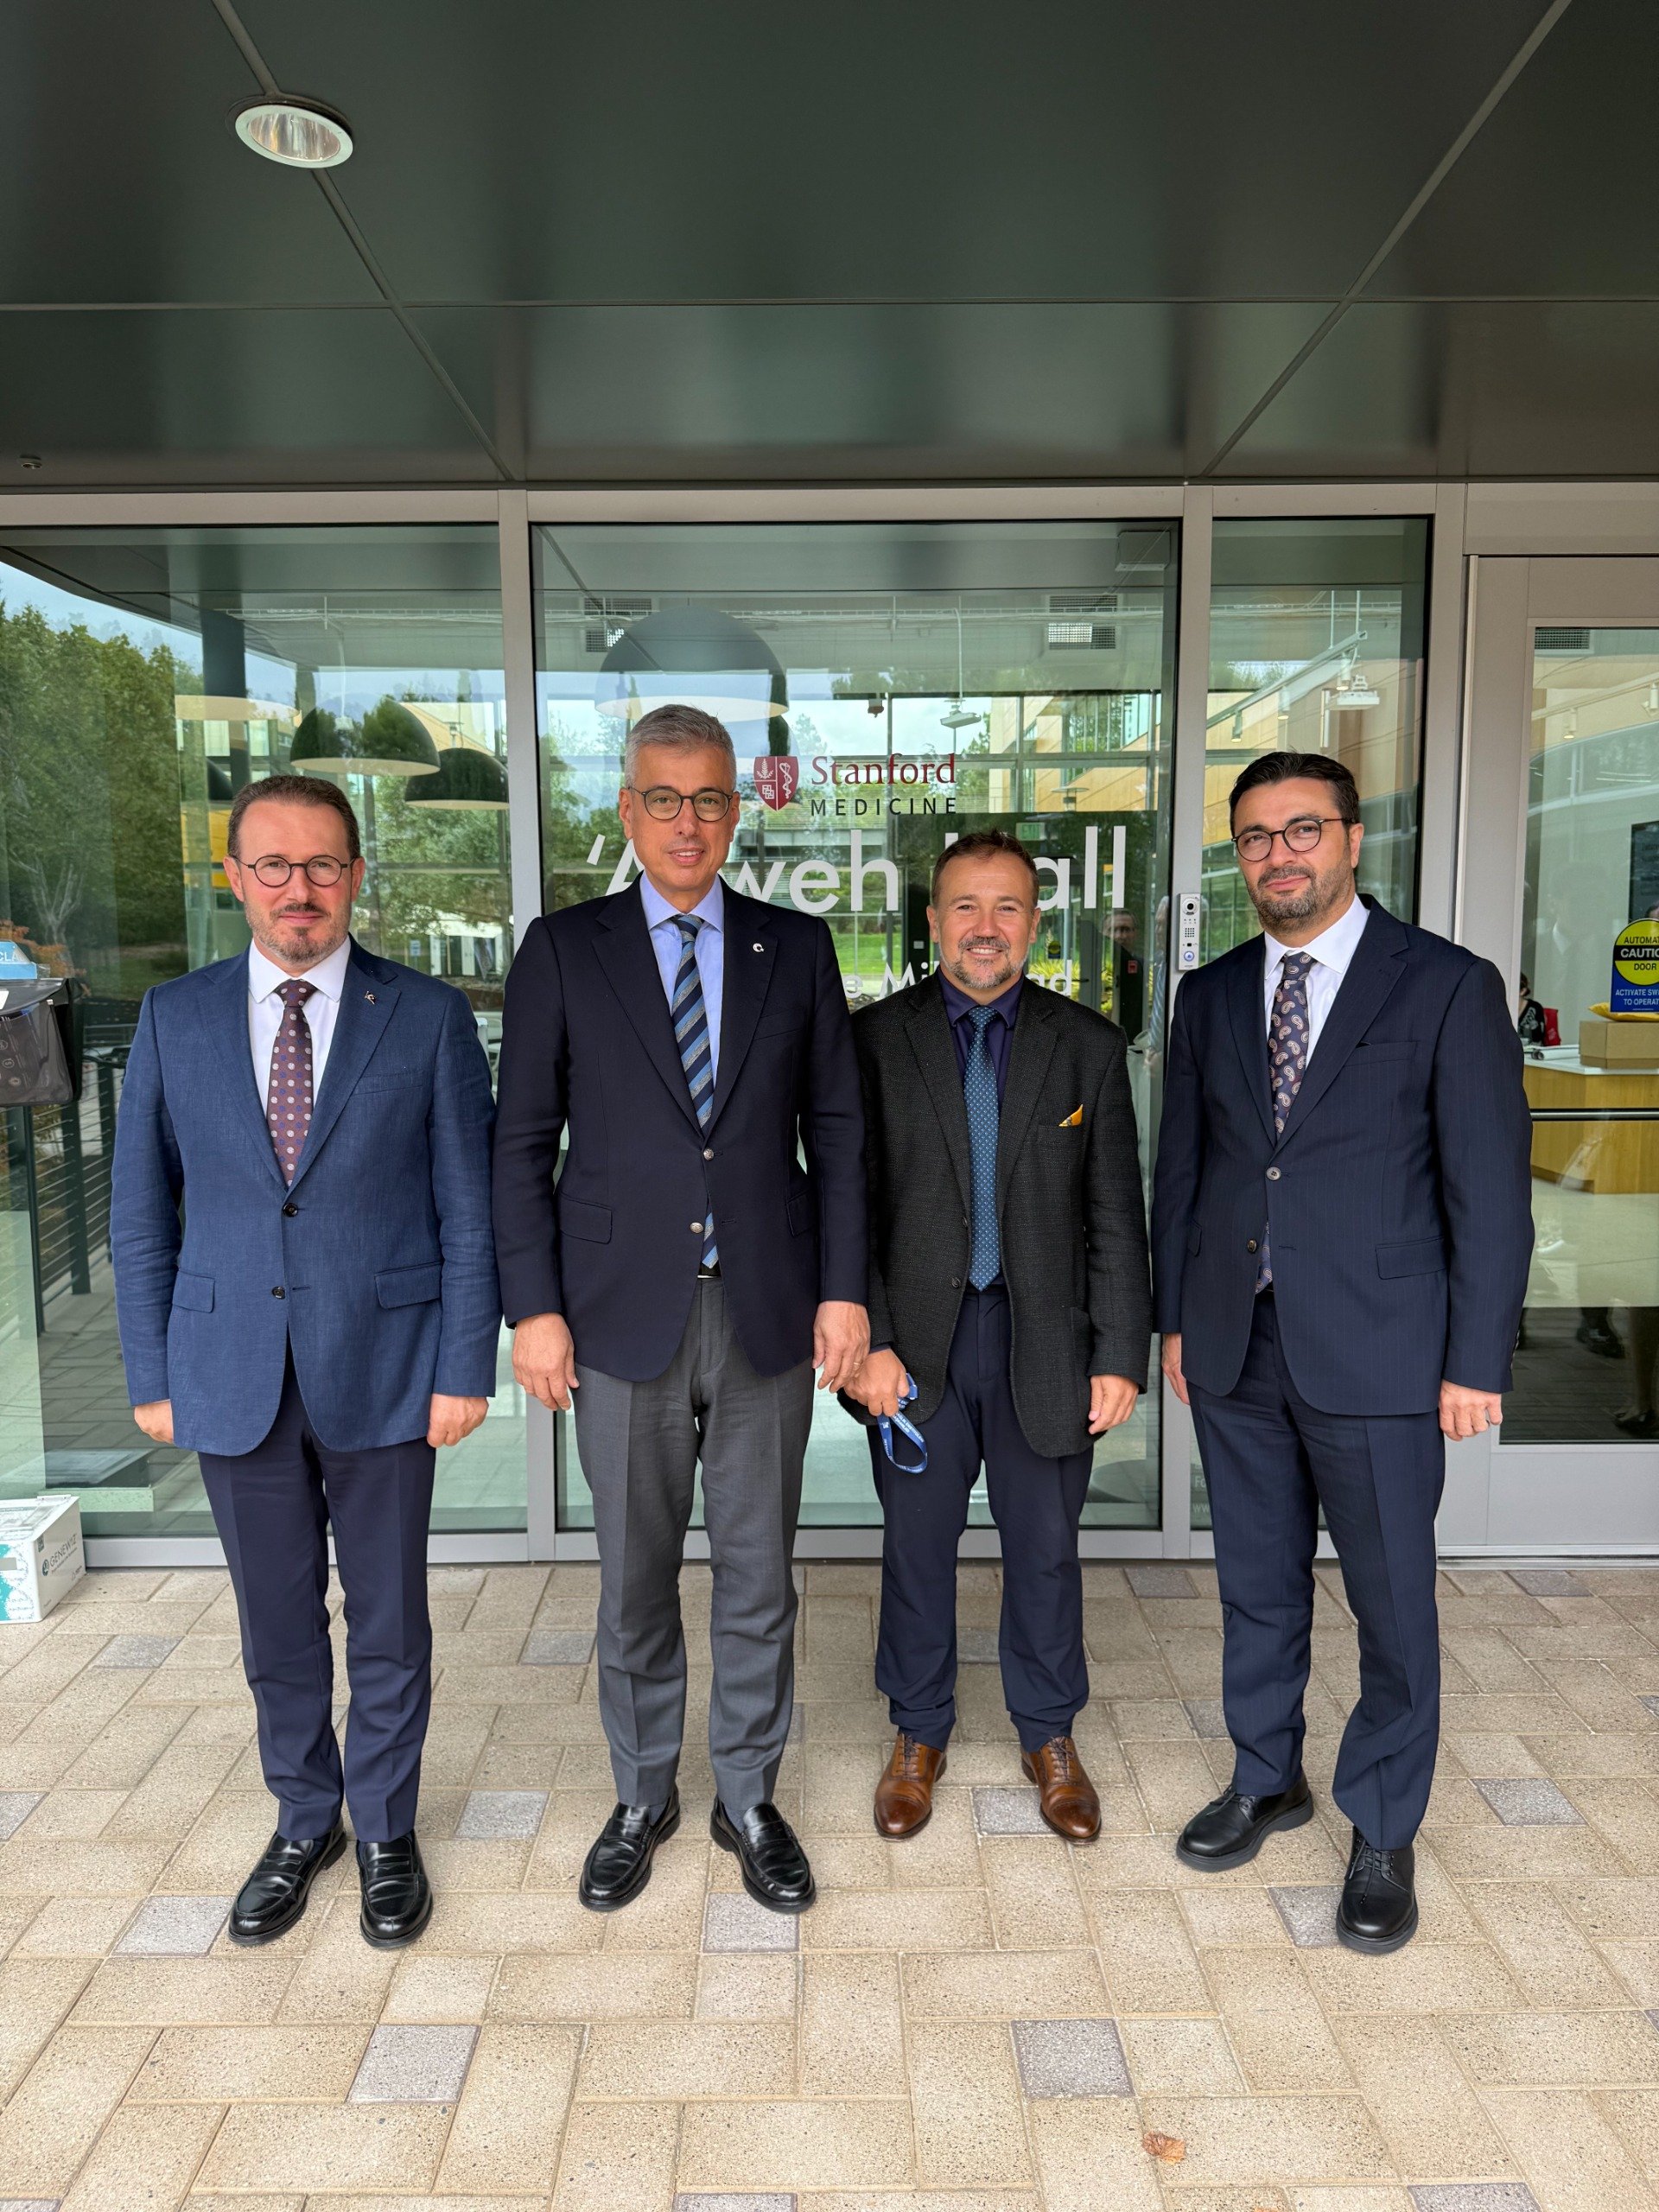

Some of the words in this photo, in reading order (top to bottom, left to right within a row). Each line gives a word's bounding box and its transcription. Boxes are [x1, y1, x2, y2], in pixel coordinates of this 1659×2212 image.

[811, 752, 957, 785] Stanford
[810, 798, 957, 817] MEDICINE
[944, 825, 1127, 912] all
[1624, 936, 1659, 944] AUTOMA
